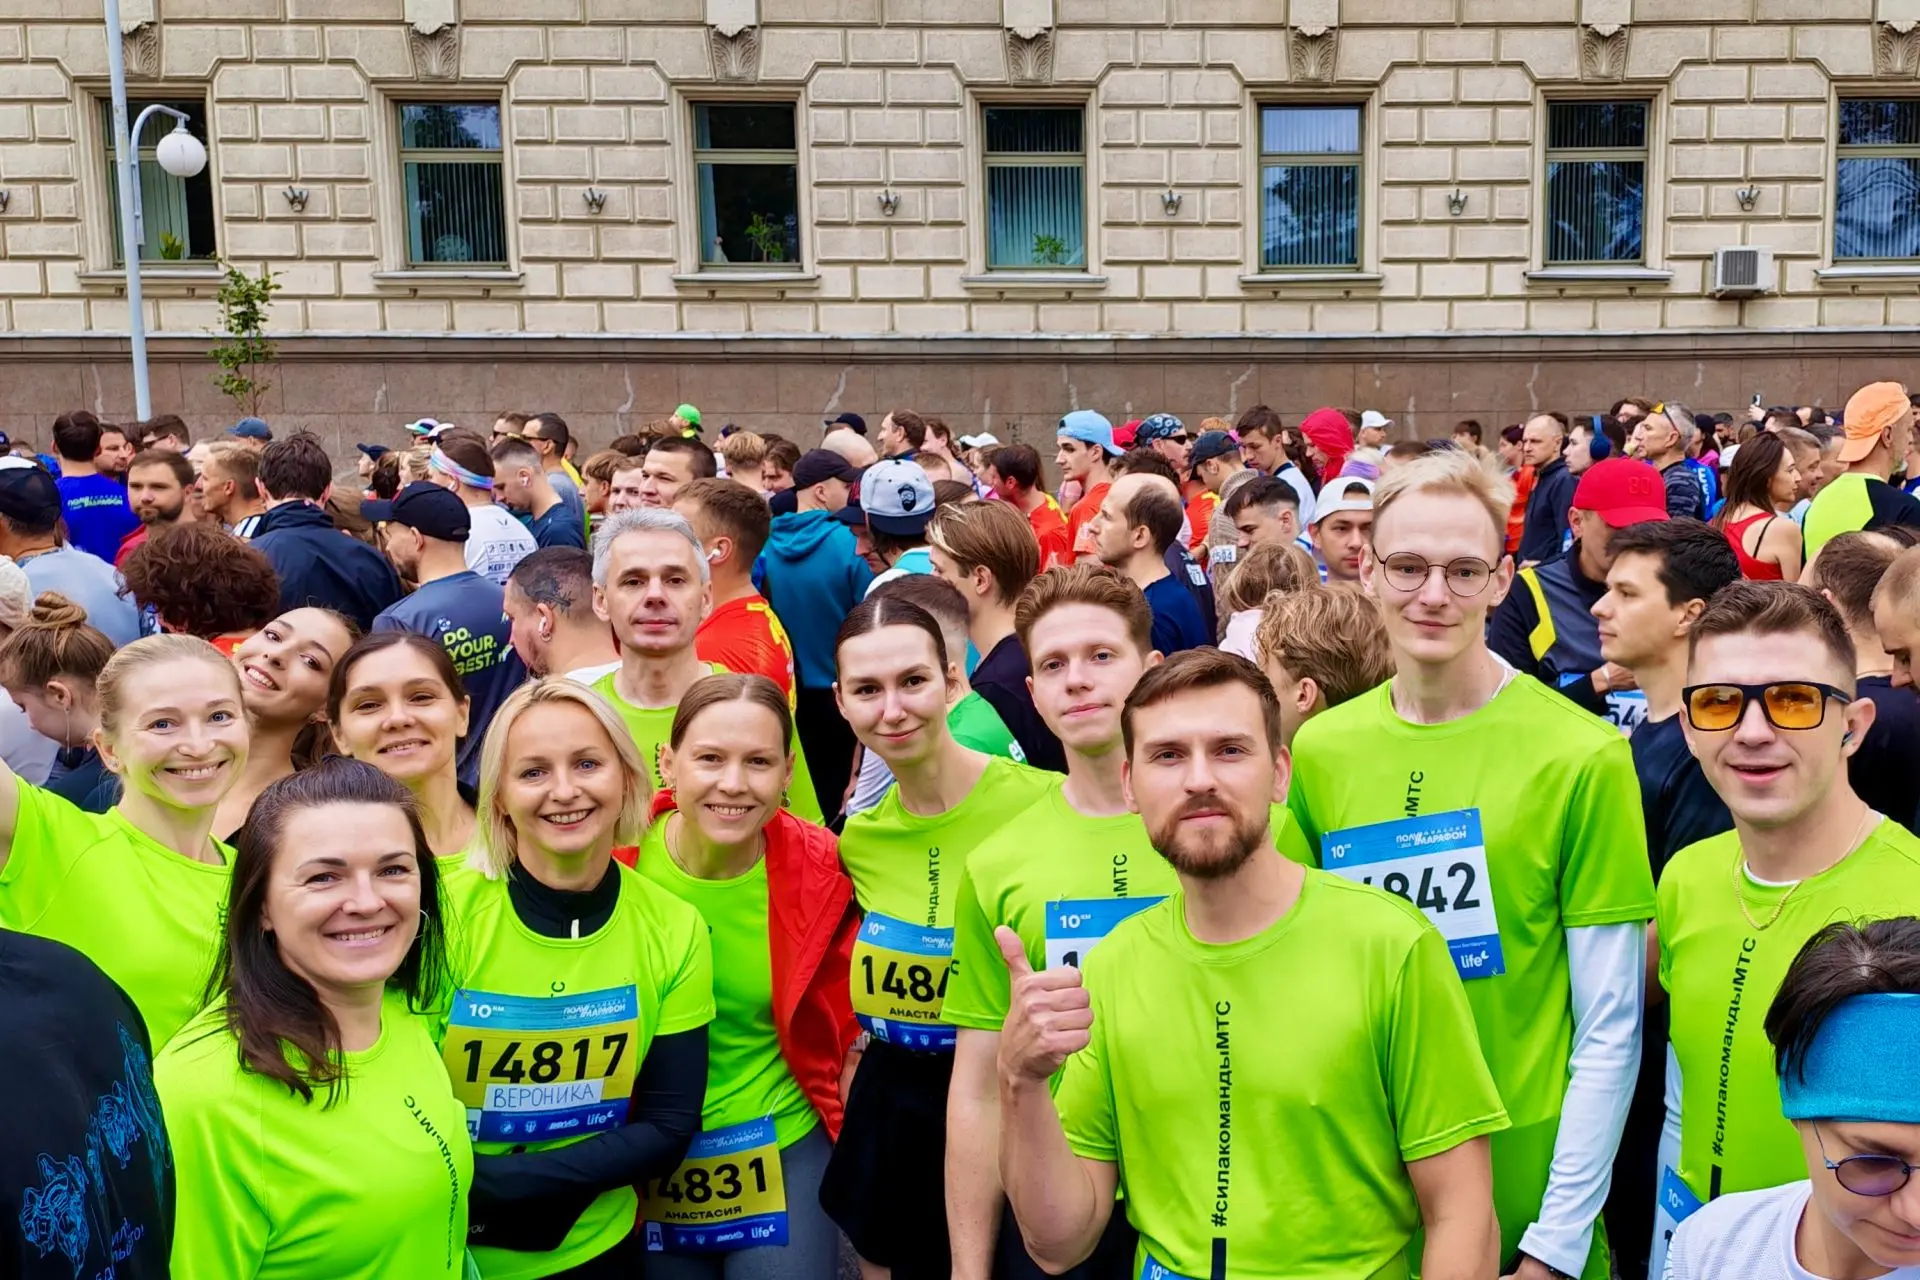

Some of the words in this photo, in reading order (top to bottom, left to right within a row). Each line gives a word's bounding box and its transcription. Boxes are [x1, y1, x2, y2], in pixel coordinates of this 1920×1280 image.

[443, 627, 472, 646] DO.
[446, 634, 498, 662] YOUR.
[1363, 861, 1481, 913] 842
[463, 1032, 629, 1085] 14817
[1711, 937, 1757, 1156] #силакомандыМТС
[493, 1083, 594, 1108] ВЕРОНИКА
[1211, 1000, 1232, 1228] #силакомандыМТС
[665, 1205, 743, 1220] АНАСТАСИЯ
